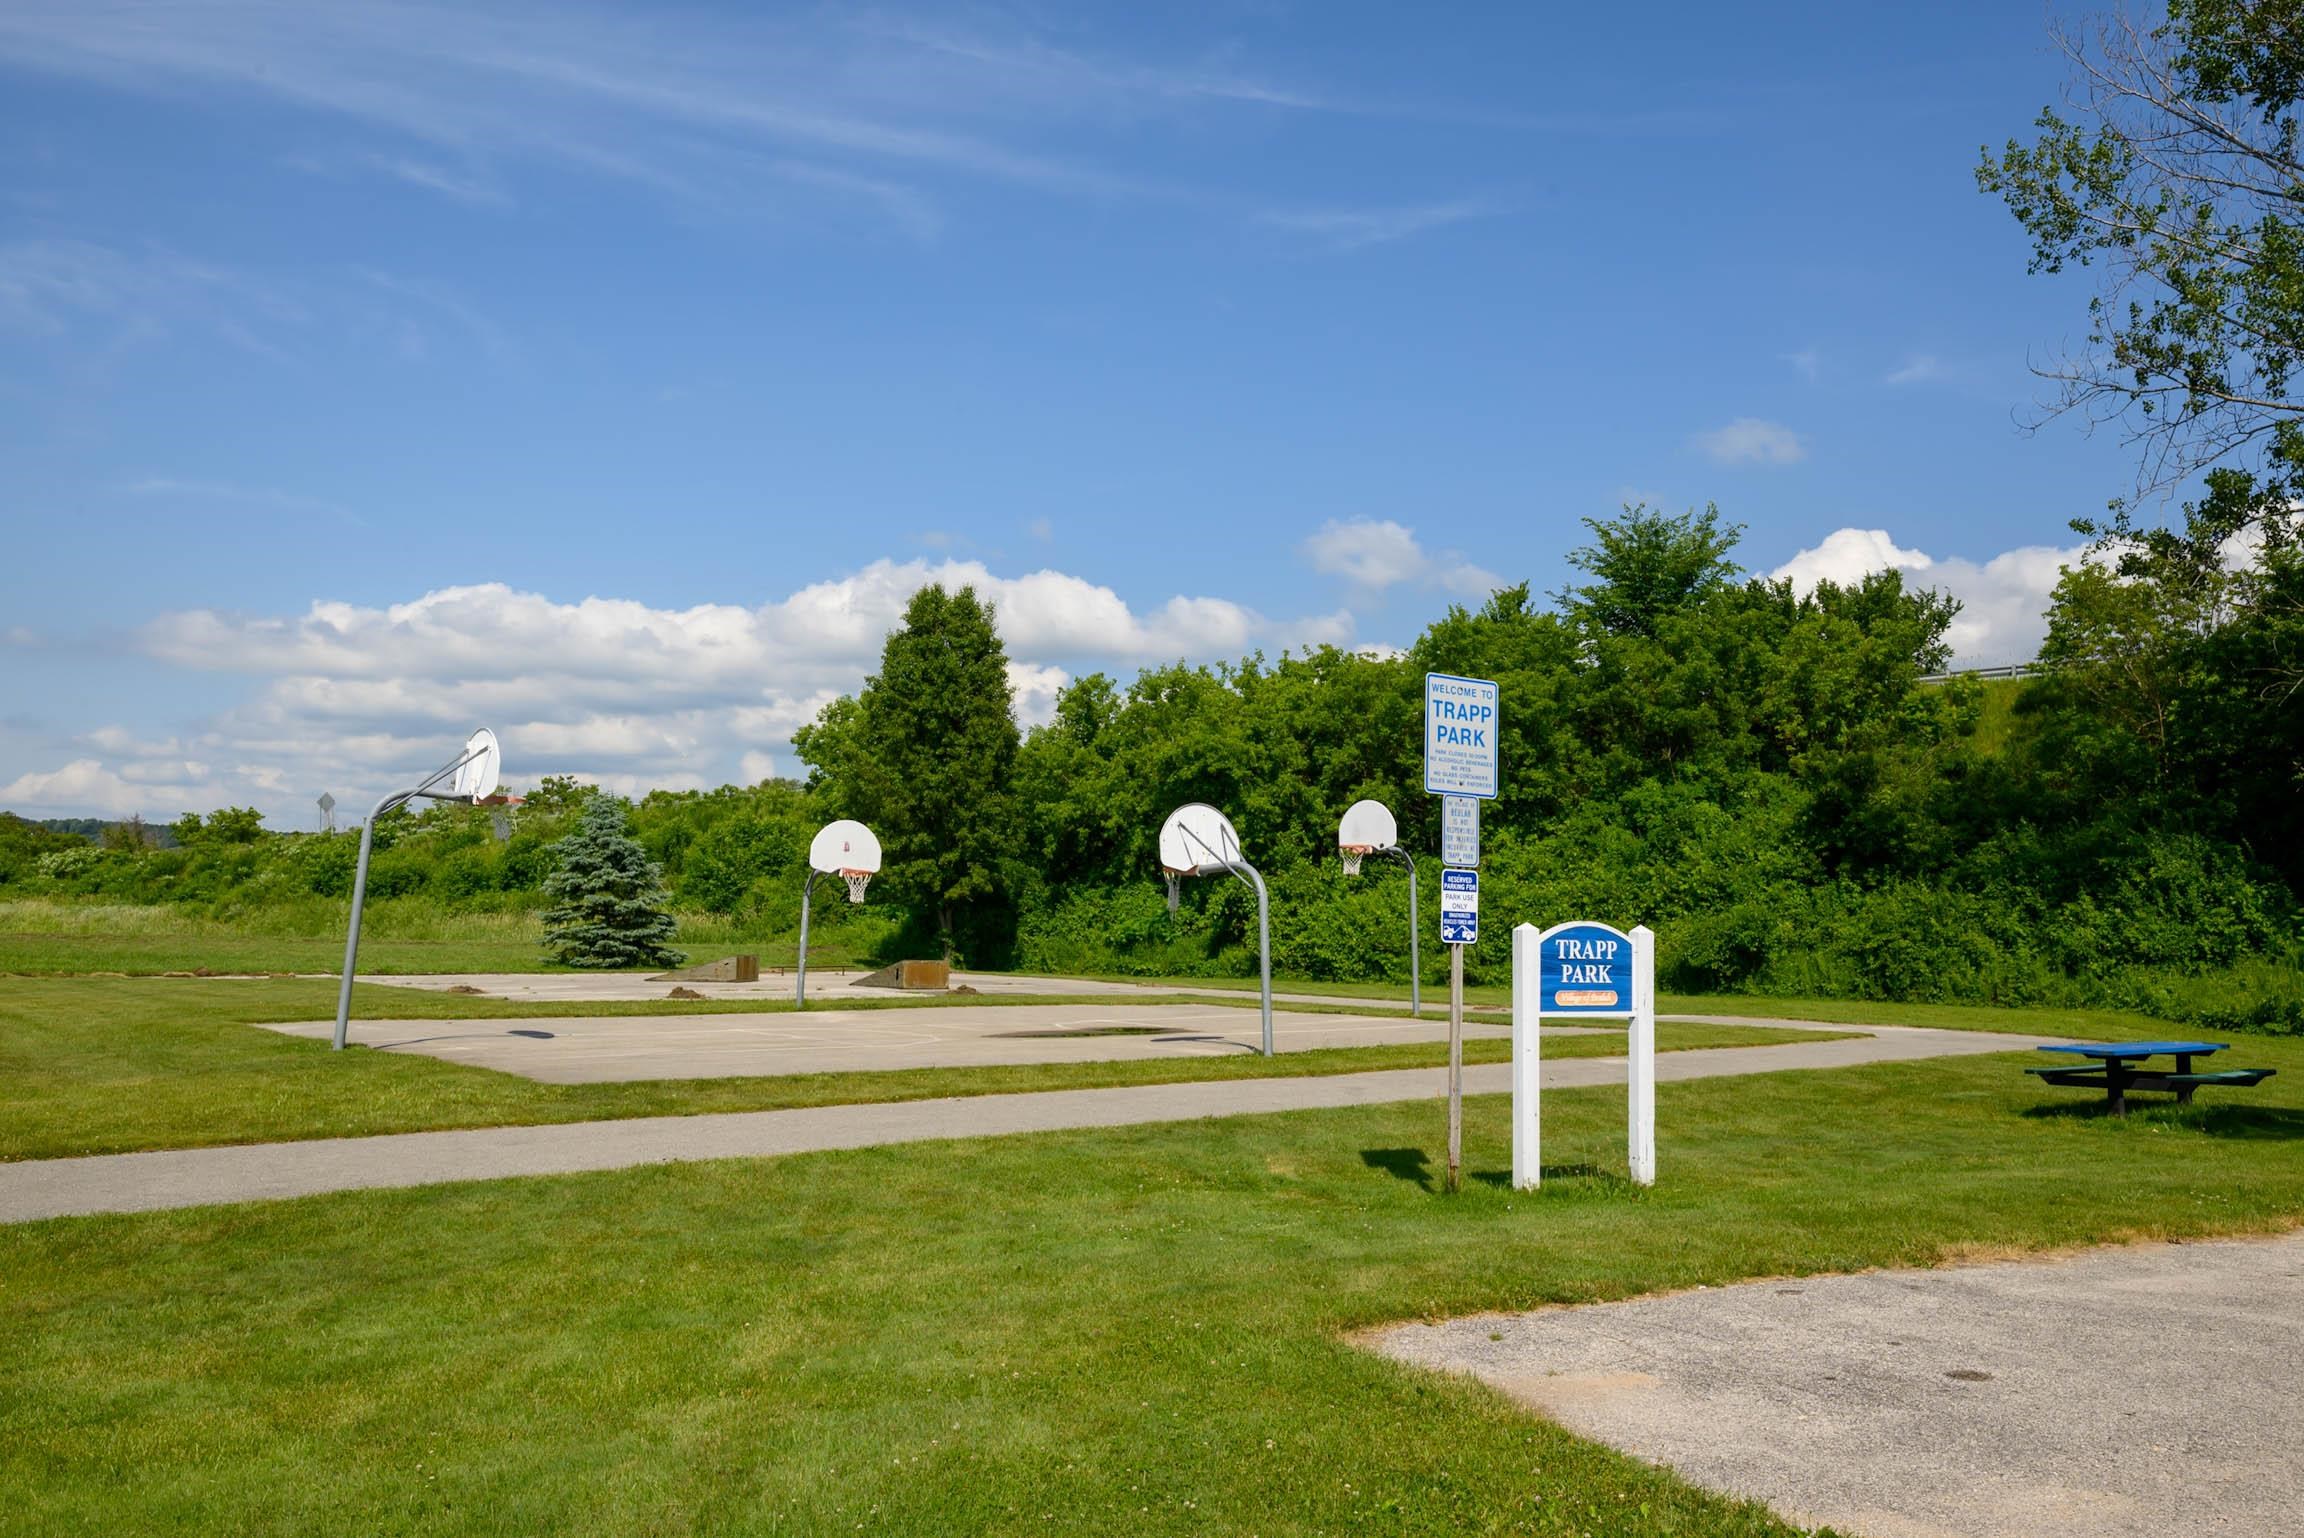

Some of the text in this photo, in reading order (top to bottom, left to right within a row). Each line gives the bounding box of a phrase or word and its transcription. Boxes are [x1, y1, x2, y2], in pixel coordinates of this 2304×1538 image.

[1432, 684, 1493, 700] WELCOME TO
[1433, 700, 1492, 722] TRAPP
[1438, 725, 1486, 748] PARK
[1448, 876, 1472, 884] RESERVED
[1556, 940, 1617, 960] TRAPP
[1560, 964, 1612, 983] PARK
